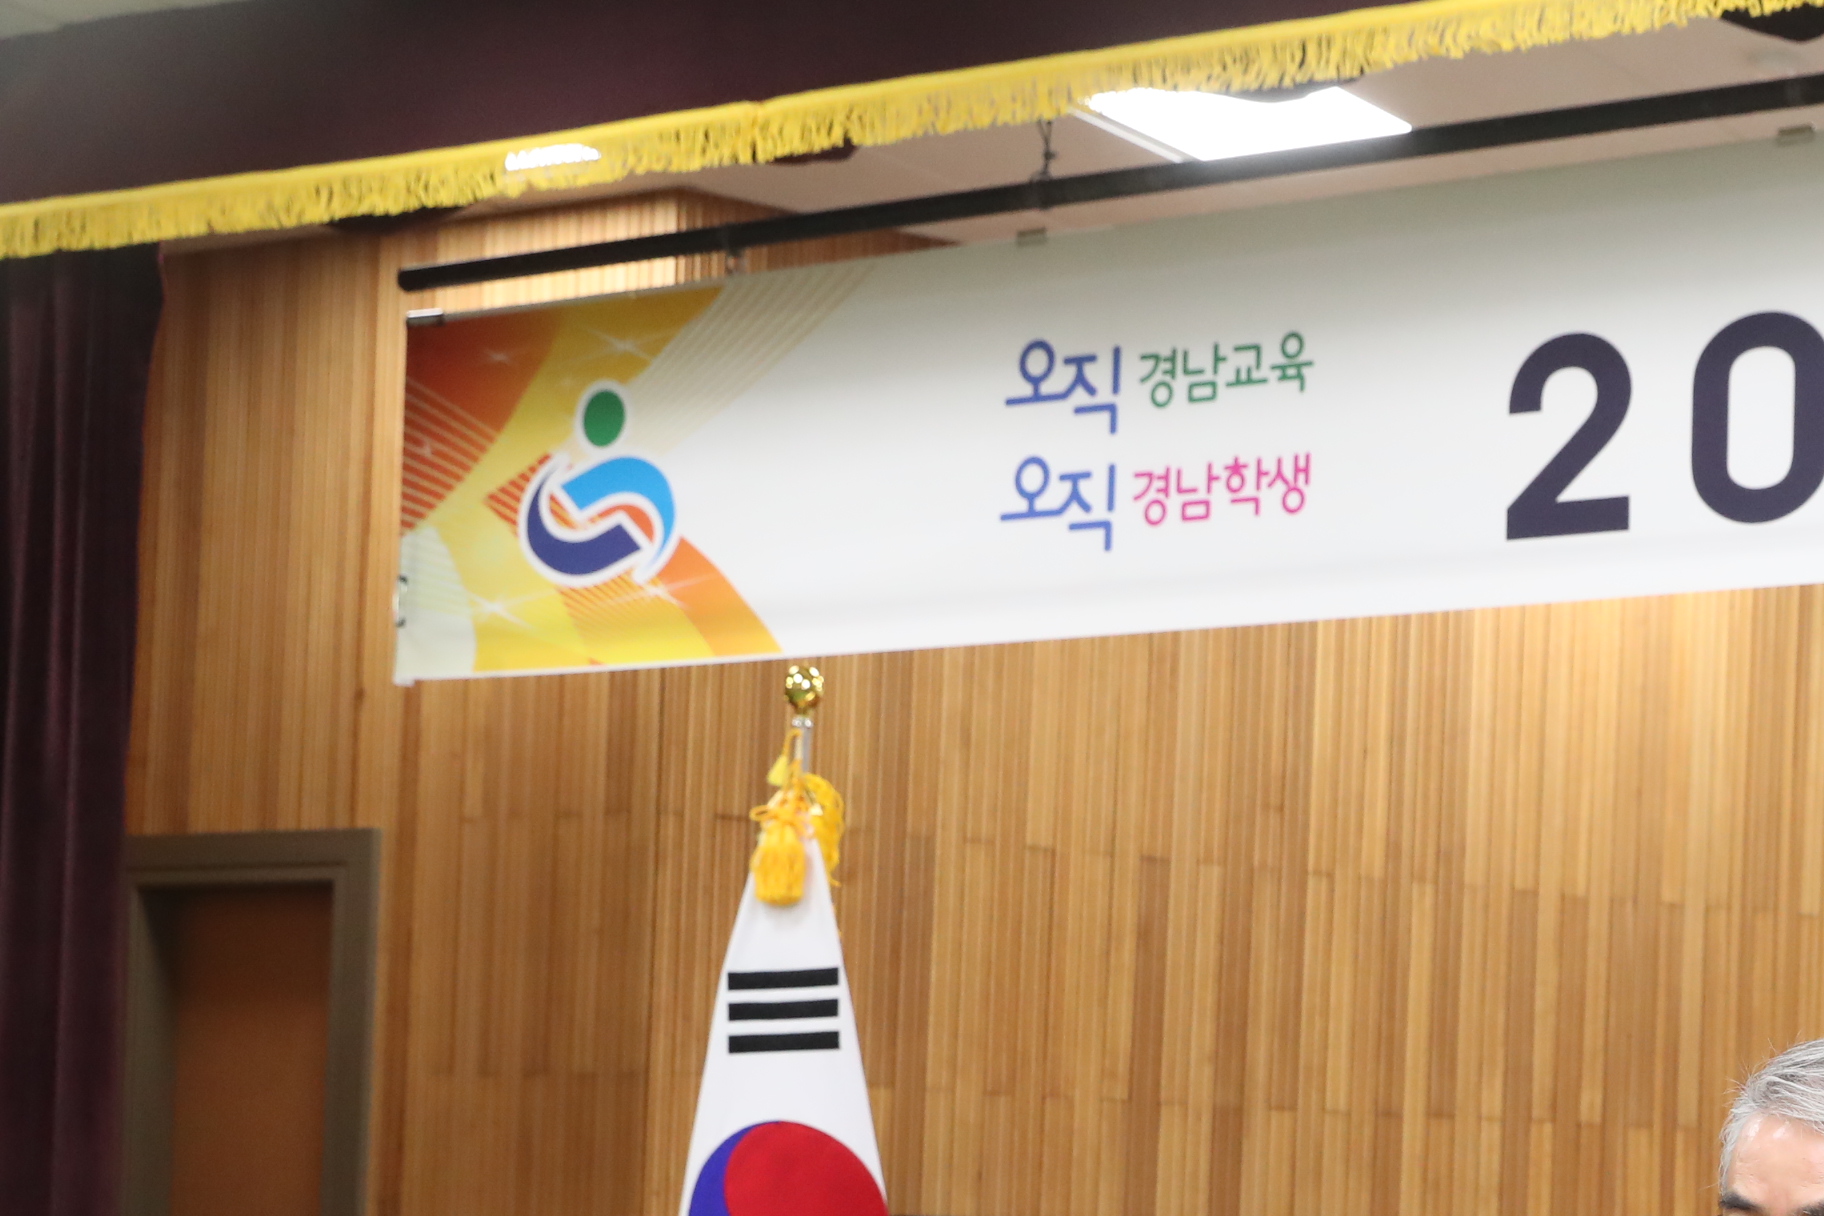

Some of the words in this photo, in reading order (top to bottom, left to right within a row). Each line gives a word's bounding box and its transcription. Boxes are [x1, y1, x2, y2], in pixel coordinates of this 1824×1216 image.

[1004, 338, 1122, 434] 오직
[1139, 331, 1315, 408] 경남교육
[1000, 456, 1117, 551] 오직
[1132, 452, 1312, 526] 경남학생
